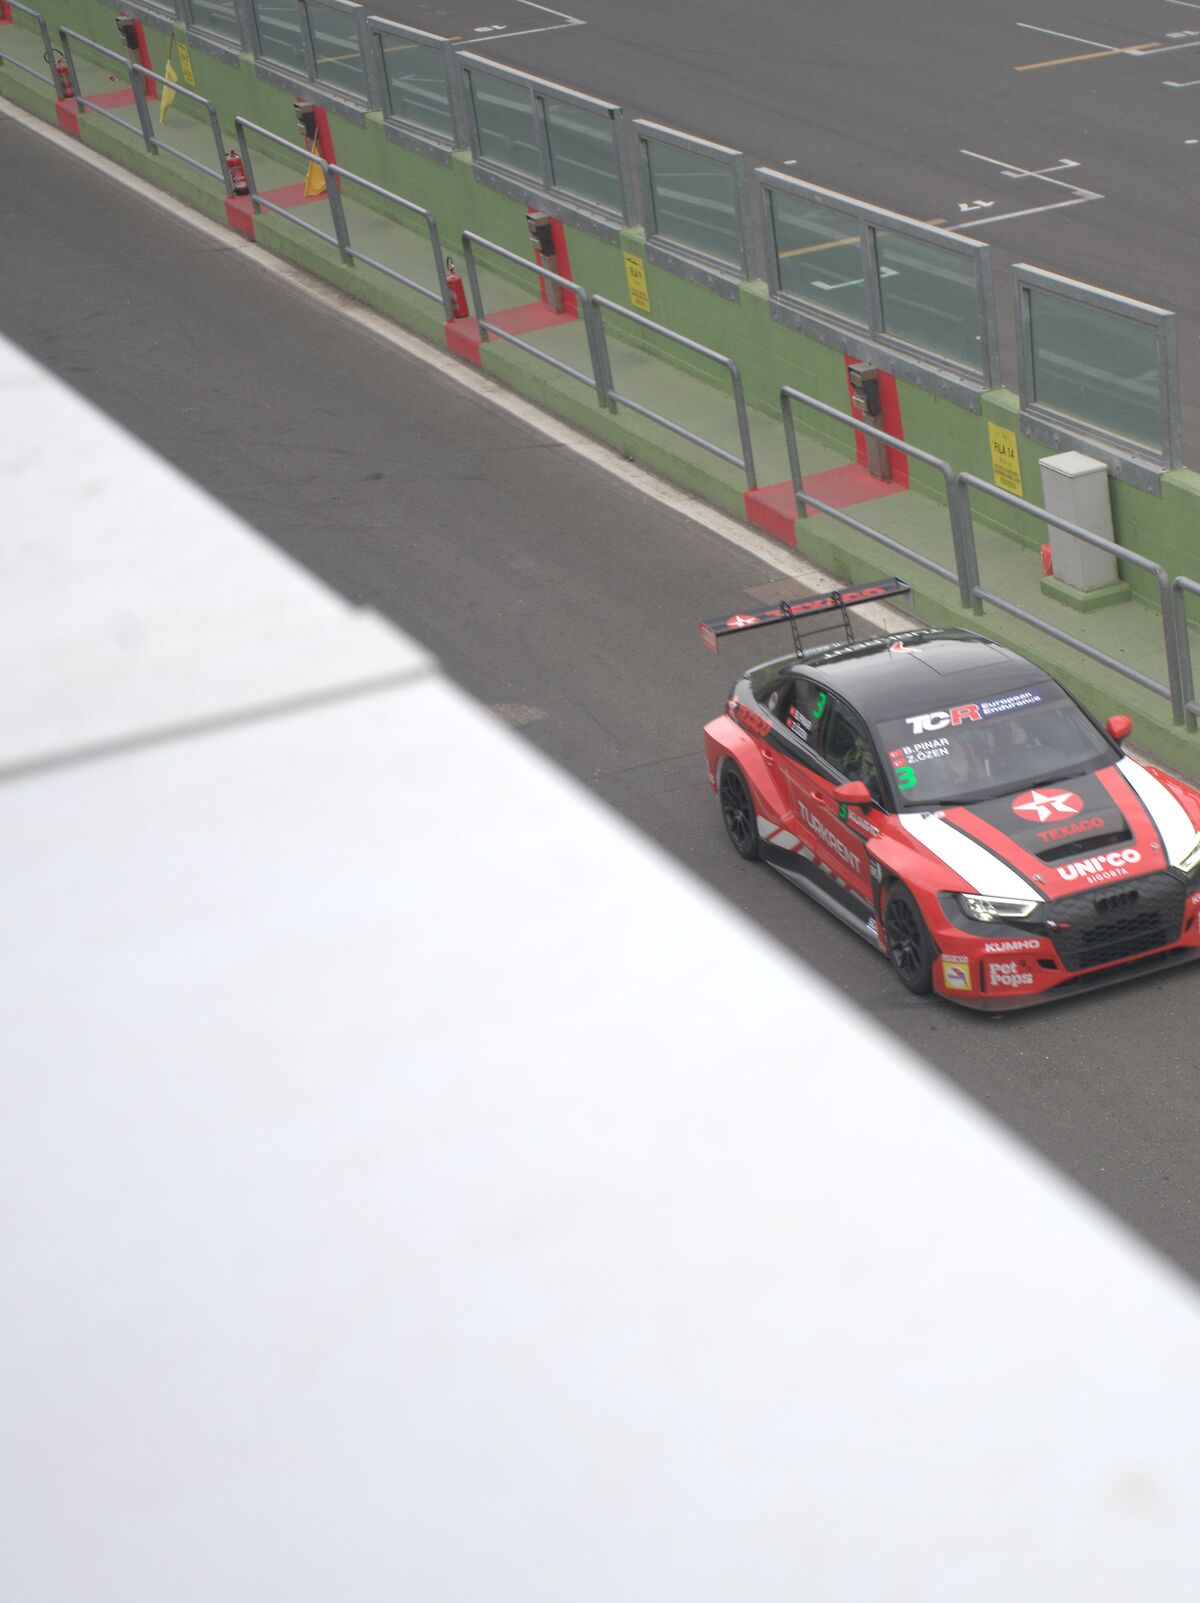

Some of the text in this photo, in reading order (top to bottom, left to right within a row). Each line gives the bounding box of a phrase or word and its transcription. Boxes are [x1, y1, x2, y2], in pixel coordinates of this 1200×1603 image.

[812, 692, 827, 719] 3
[905, 703, 983, 735] TCR
[895, 766, 917, 791] 3
[1036, 816, 1105, 843] TEXACO
[1086, 867, 1129, 884] SIGORTA
[984, 940, 1041, 952] KUMHO
[988, 960, 1018, 975] Pet
[990, 973, 1034, 988] Pops
